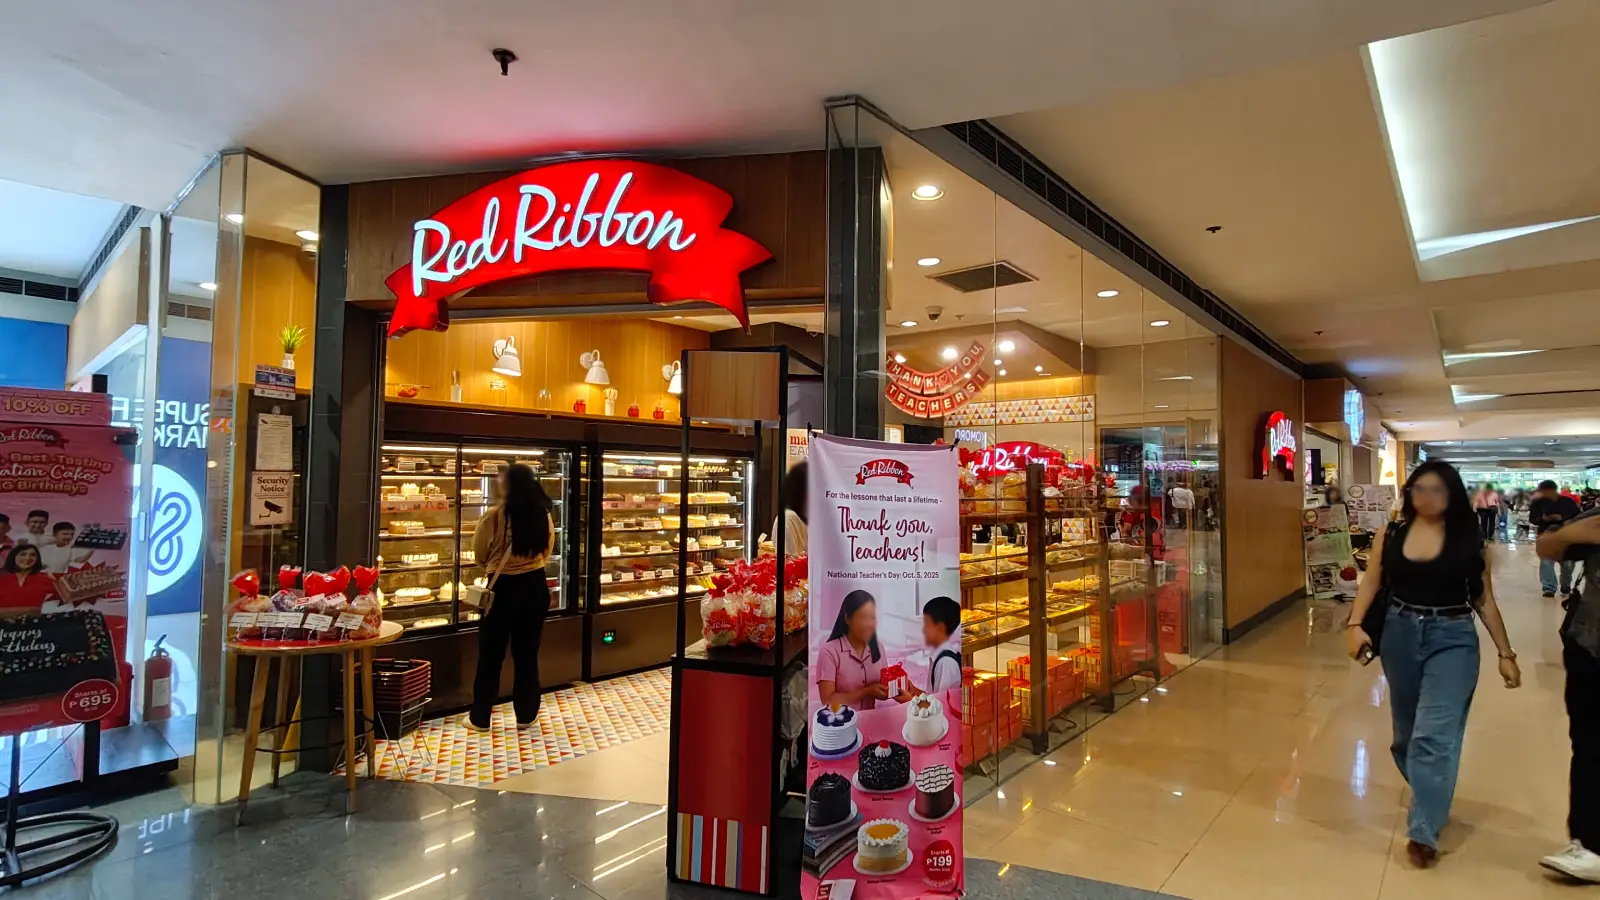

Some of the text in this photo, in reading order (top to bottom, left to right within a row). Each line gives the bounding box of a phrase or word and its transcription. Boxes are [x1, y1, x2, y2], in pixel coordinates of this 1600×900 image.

[411, 172, 696, 297] Red Ribbon
[885, 355, 936, 387] THANK
[5, 398, 92, 415] 10% OFF
[51, 463, 98, 483] Cakes
[861, 461, 905, 479] Red Ribbon
[17, 480, 87, 495] Birthdays
[257, 476, 290, 485] Security
[825, 491, 838, 499] For
[851, 493, 878, 501] lessons
[879, 494, 893, 502] that
[894, 495, 907, 503] last
[913, 496, 938, 504] lifetime
[838, 506, 933, 537] Thank you,
[847, 535, 925, 562] Teachers!
[827, 571, 858, 579] National
